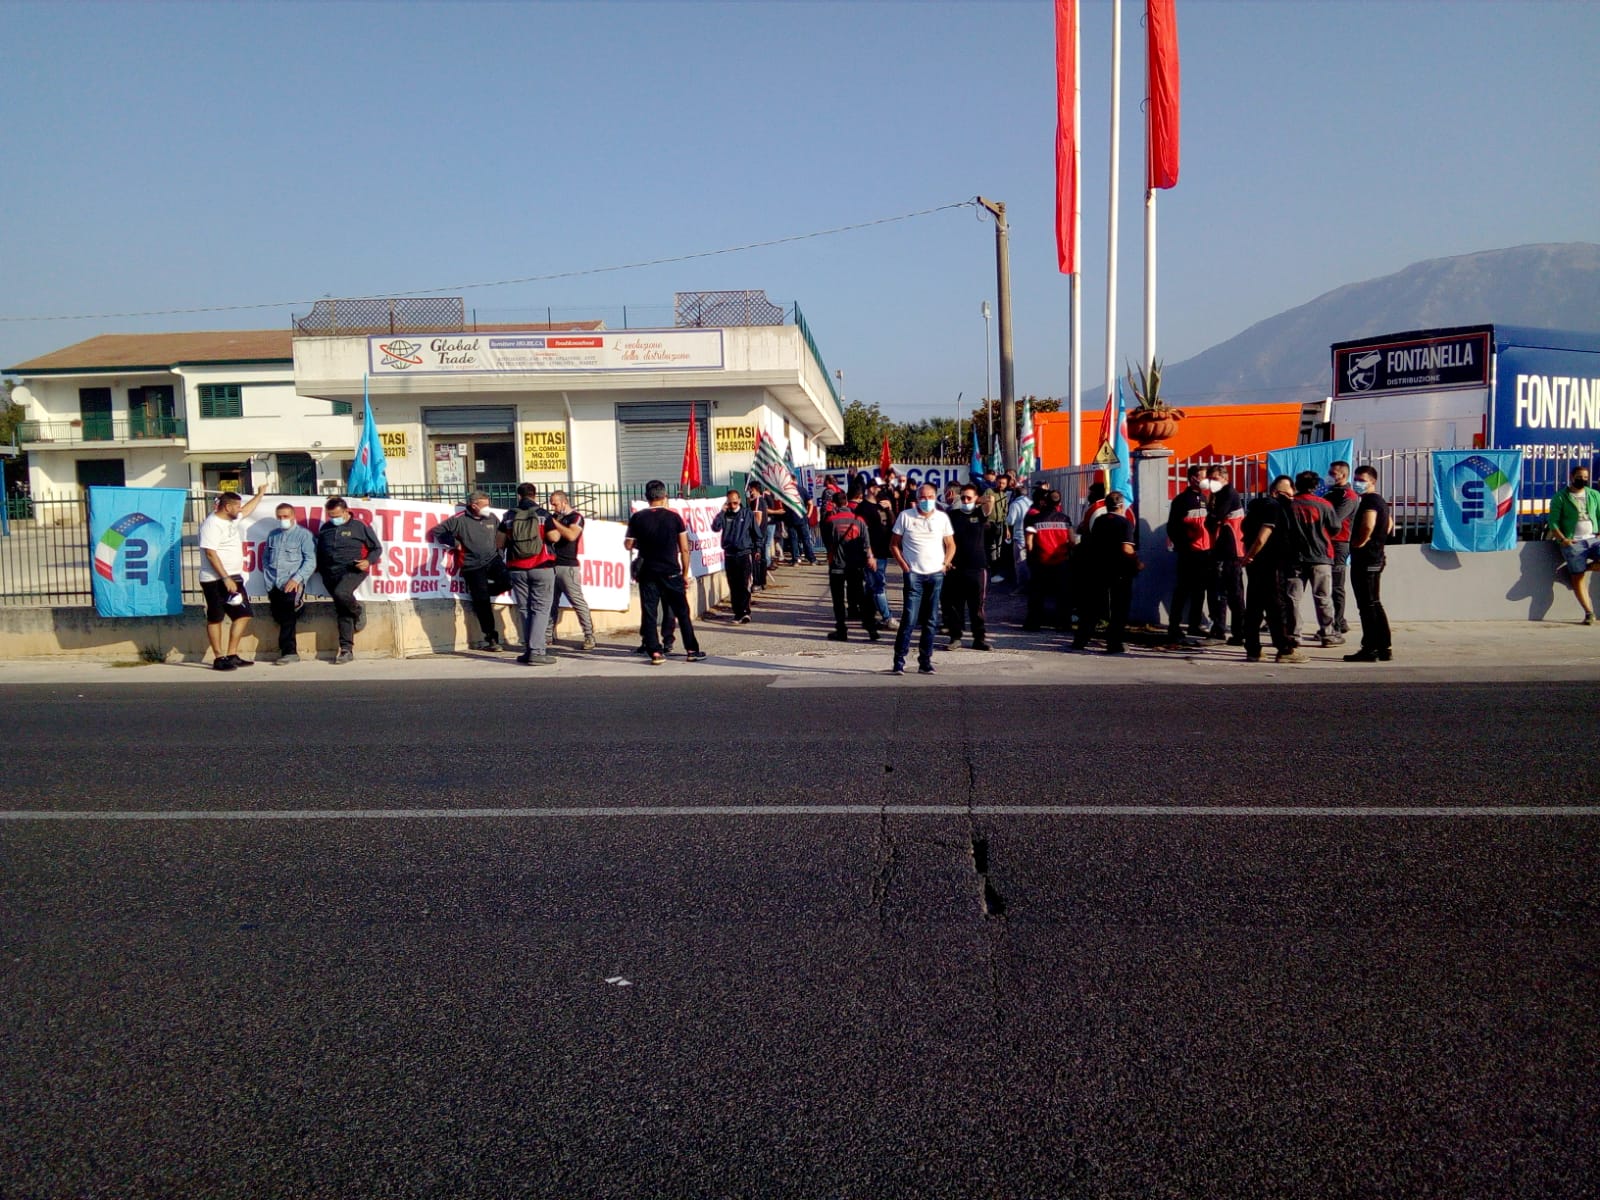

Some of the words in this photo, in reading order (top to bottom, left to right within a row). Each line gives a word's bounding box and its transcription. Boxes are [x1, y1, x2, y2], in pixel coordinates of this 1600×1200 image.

[430, 338, 480, 352] Global
[438, 352, 476, 364] Trade
[1387, 343, 1473, 374] FONTANELLA
[1387, 374, 1440, 386] DISTRIBUZIONE
[524, 432, 566, 445] FITTASI
[716, 426, 755, 439] FITTASI
[377, 433, 406, 445] TASI
[383, 447, 406, 457] 932178
[717, 441, 756, 452] 349.5932178
[546, 451, 560, 459] 500
[526, 459, 567, 470] 349.5932178
[1462, 480, 1484, 524] UIL
[580, 559, 625, 589] ATRO
[373, 580, 407, 594] FIOM
